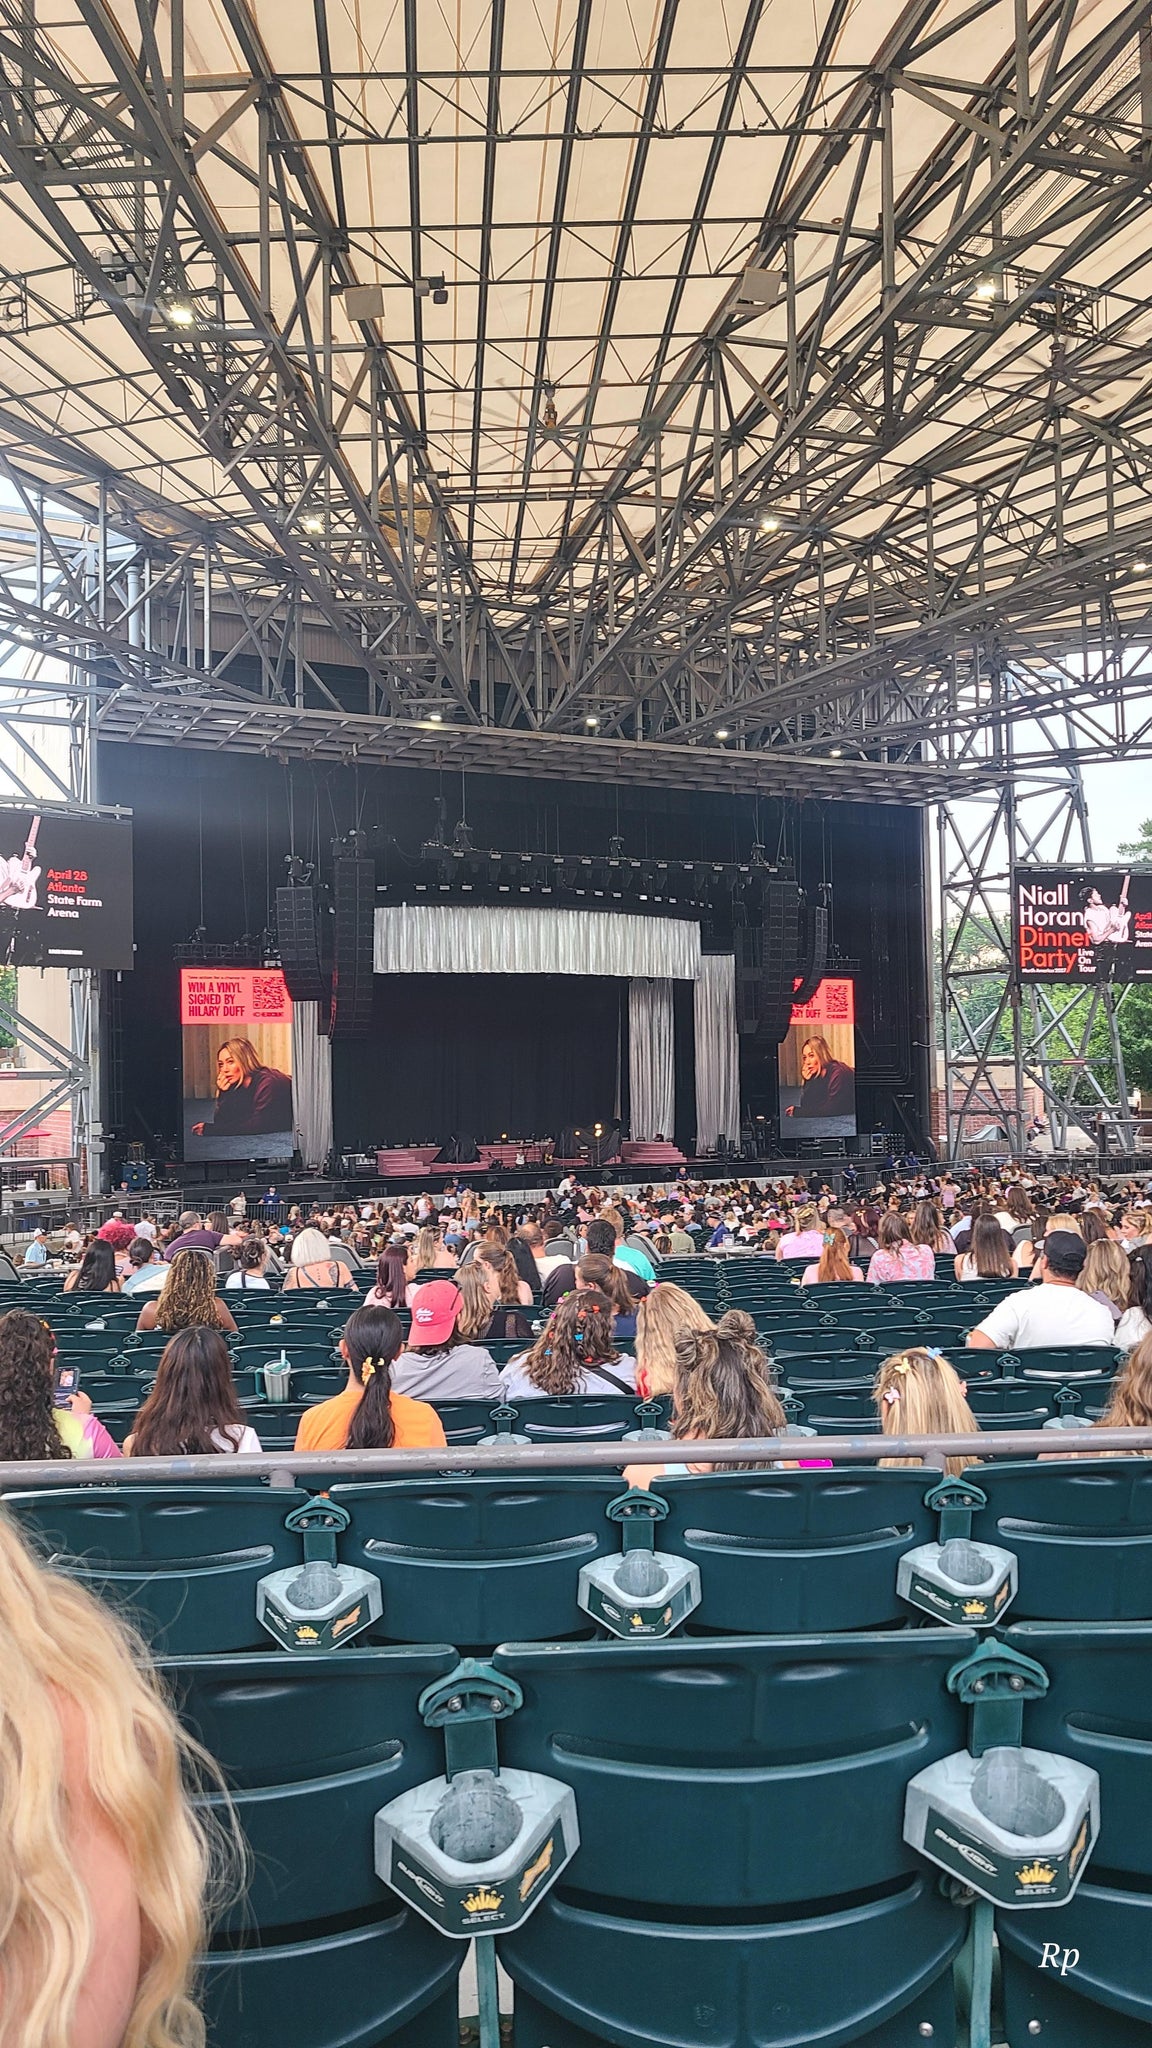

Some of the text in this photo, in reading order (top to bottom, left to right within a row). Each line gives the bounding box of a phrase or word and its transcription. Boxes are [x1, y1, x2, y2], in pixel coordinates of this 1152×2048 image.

[47, 869, 72, 881] April
[47, 882, 85, 893] Atlanta
[1019, 883, 1069, 905] Niall
[47, 894, 103, 907] State Farm
[47, 907, 79, 918] Arena
[1020, 905, 1083, 926] Horan
[1020, 926, 1090, 947] Dinner
[1077, 948, 1095, 957] Live
[1020, 946, 1078, 974] Party
[1078, 956, 1092, 964] On
[1077, 964, 1097, 973] Tour
[188, 982, 242, 993] WIN A VINYL
[188, 994, 235, 1005] SIGNED BY
[188, 1006, 220, 1017] HILARY
[223, 1006, 245, 1017] DUFF
[806, 1009, 821, 1018] DUFF
[1015, 1886, 1058, 1896] SELECT
[461, 1912, 506, 1925] SELECT
